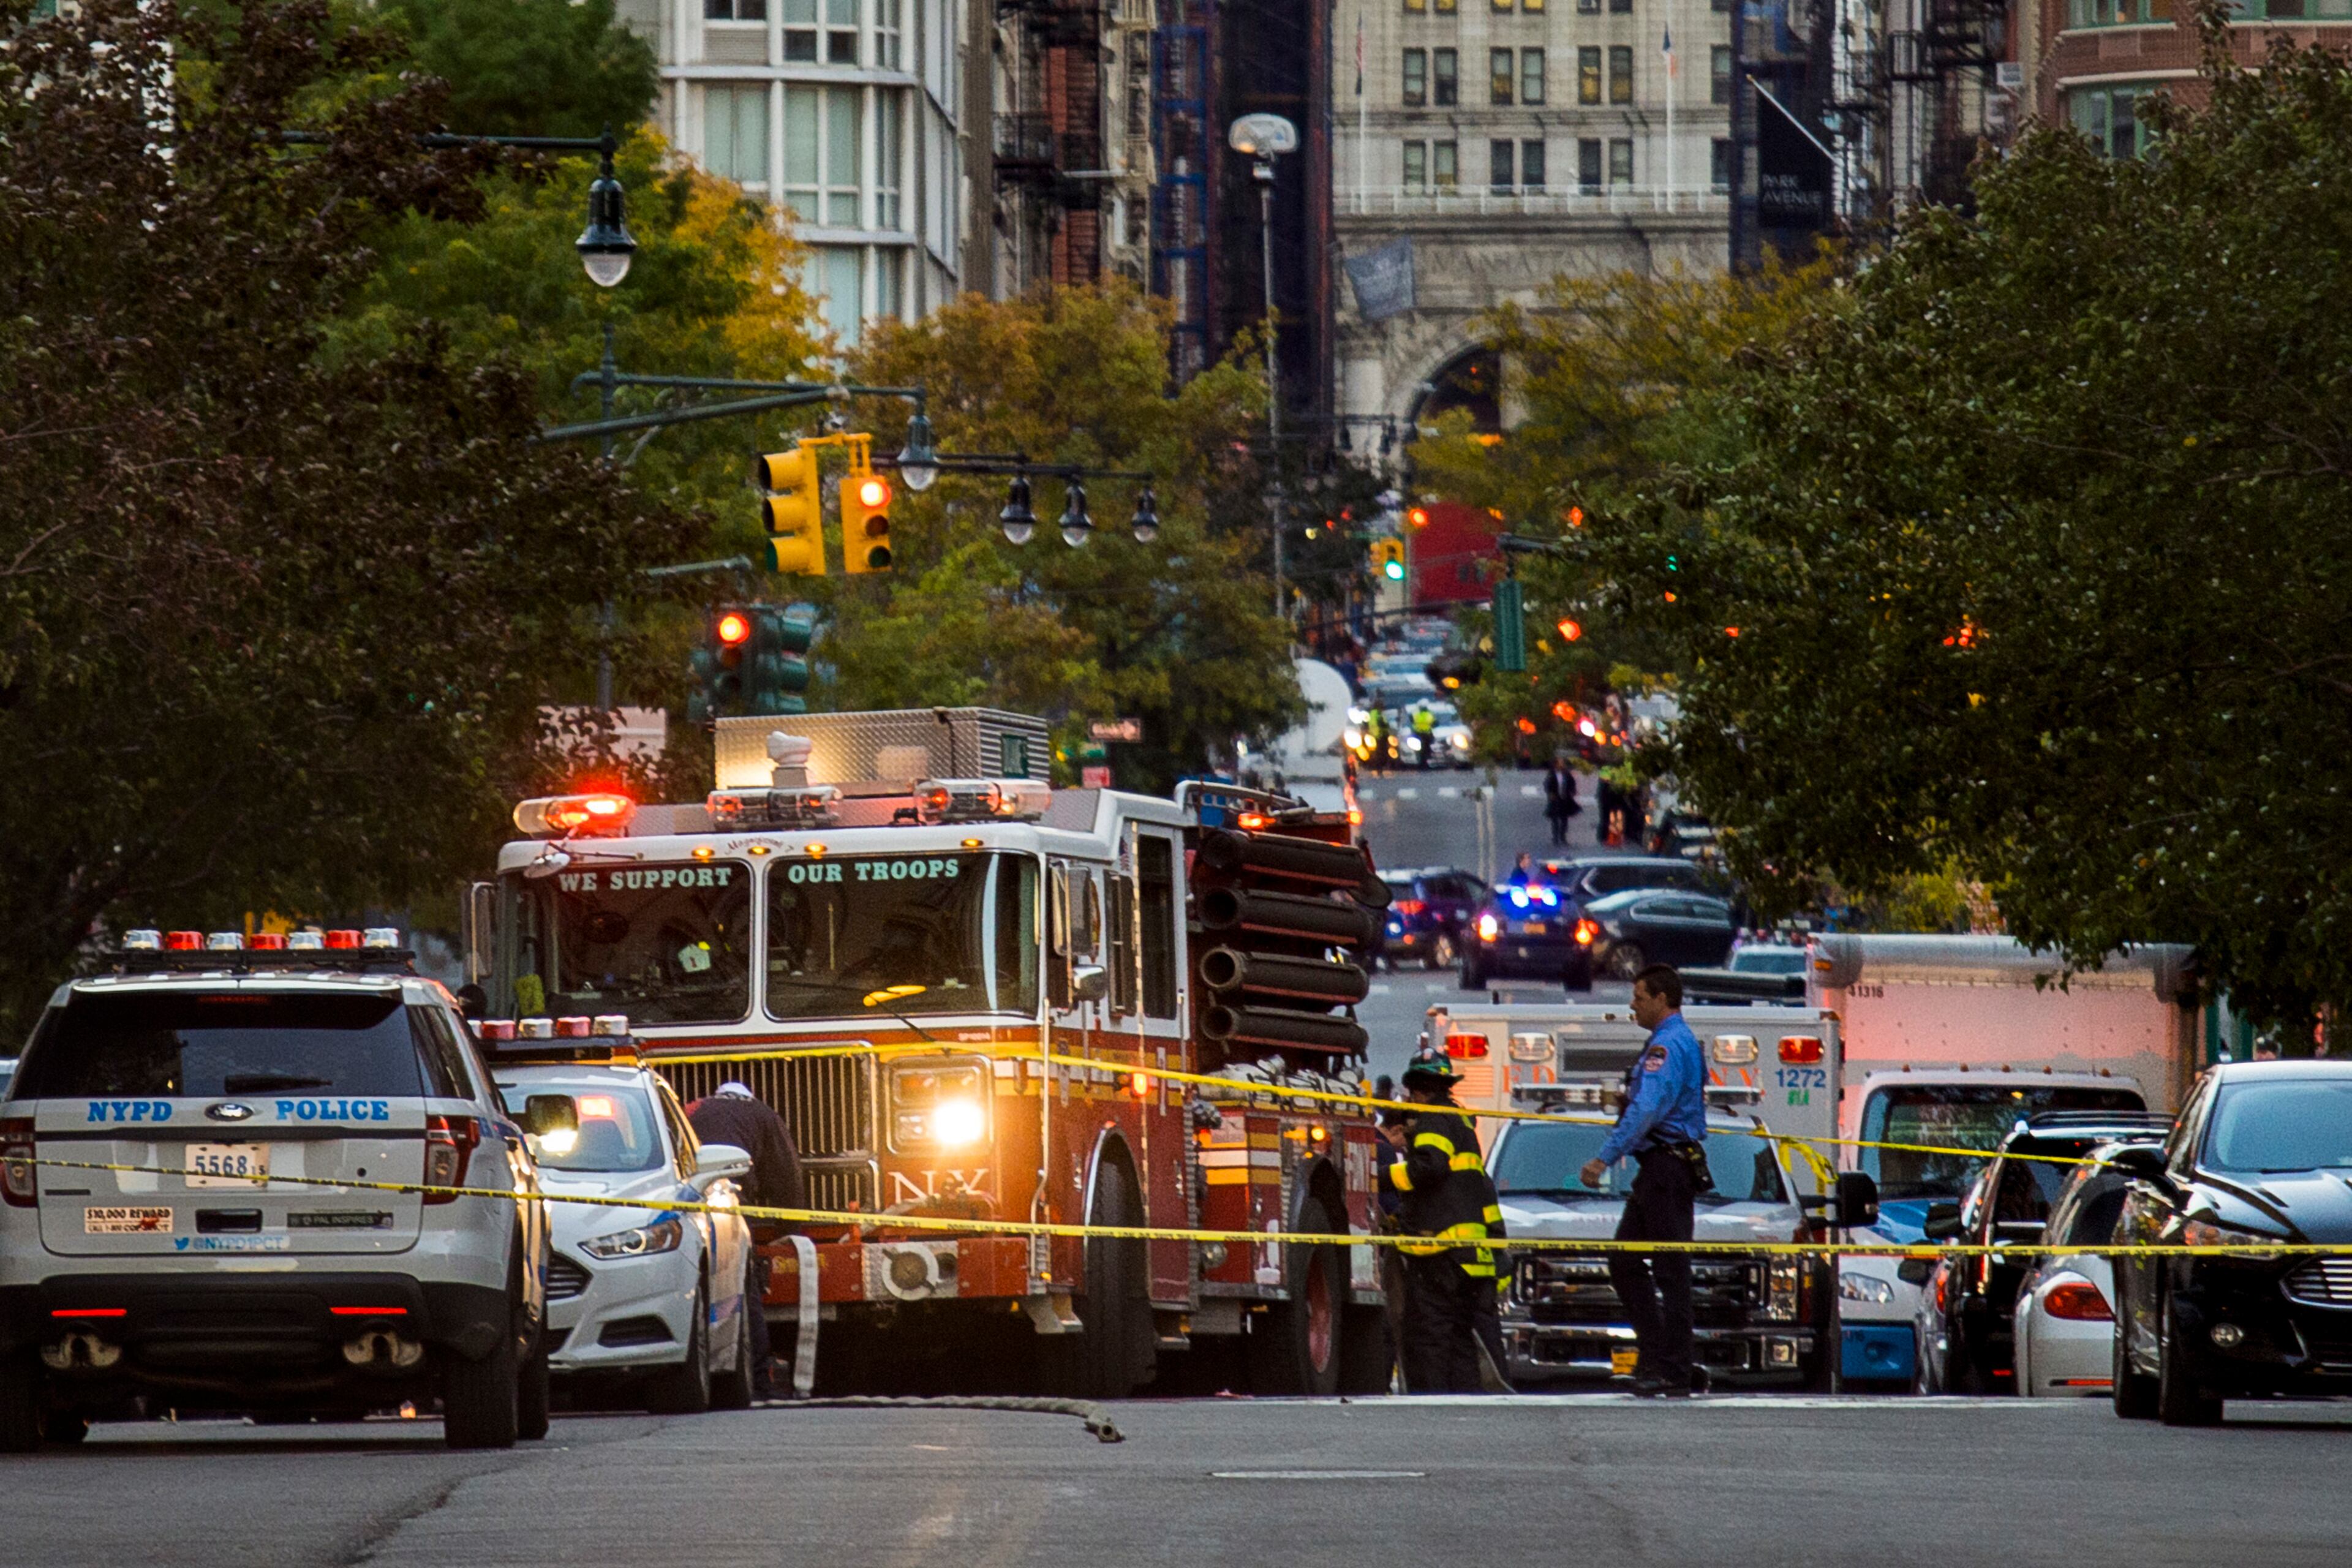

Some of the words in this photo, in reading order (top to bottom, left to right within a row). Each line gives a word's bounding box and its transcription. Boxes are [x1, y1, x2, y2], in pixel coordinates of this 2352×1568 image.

[1762, 175, 1798, 187] PARK
[1763, 190, 1822, 205] AVENUE
[558, 872, 597, 892] WE
[609, 867, 732, 889] SUPPORT
[788, 864, 843, 883] OUR
[855, 859, 959, 881] TROOPS
[1775, 1068, 1827, 1088] 1272
[87, 1101, 173, 1122] NYPD
[275, 1100, 389, 1121] POLICE
[195, 1155, 247, 1176] 5568
[87, 1208, 126, 1220] $10,000
[129, 1208, 170, 1219] REWARD
